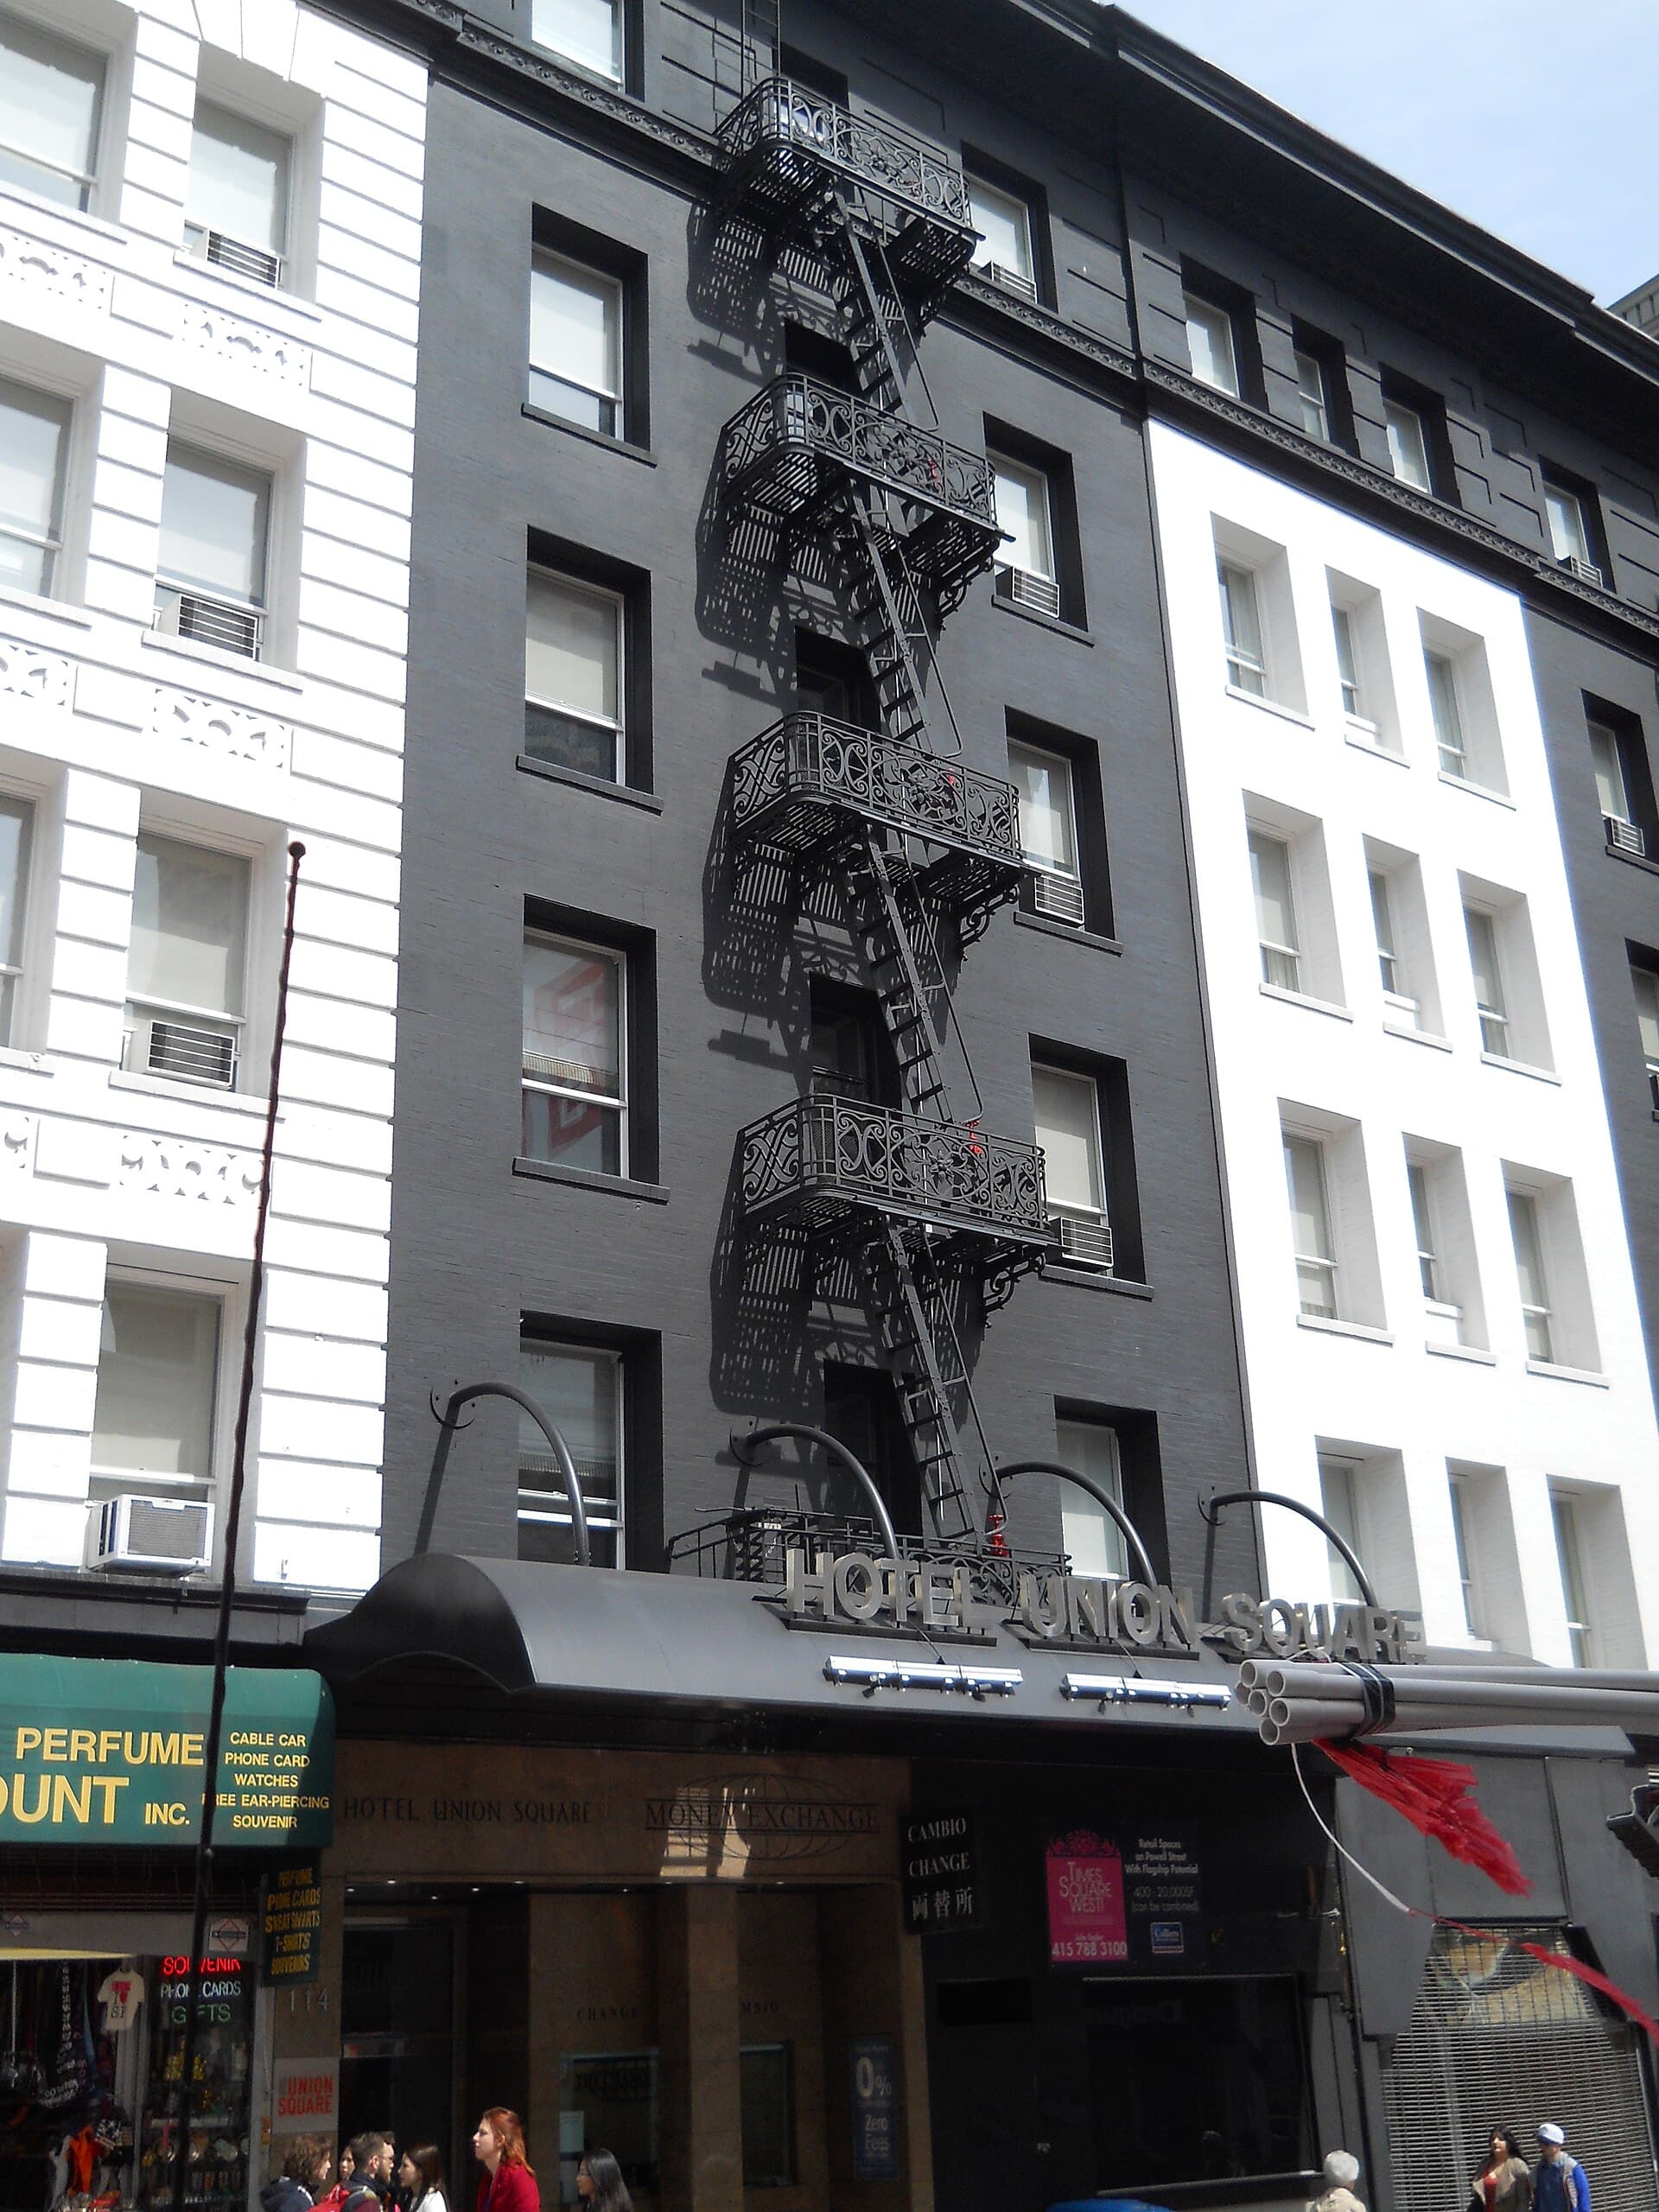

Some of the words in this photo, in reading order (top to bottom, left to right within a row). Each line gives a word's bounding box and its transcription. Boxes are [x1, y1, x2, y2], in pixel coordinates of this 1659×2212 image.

[785, 1548, 994, 1630] HOTEL
[1020, 1573, 1198, 1645] UNION
[1219, 1592, 1426, 1663] SQUARE
[16, 1726, 205, 1766] PERFUME
[230, 1732, 274, 1746] CABLE
[279, 1734, 307, 1747] CAR
[225, 1752, 269, 1767] PHONE
[274, 1754, 310, 1768] CARD
[234, 1774, 299, 1789] WATCHES
[0, 1773, 130, 1825] UNT
[144, 1802, 190, 1826] INC.
[241, 1794, 329, 1809] EAR-PIERCING
[343, 1796, 419, 1821] HOTEL
[433, 1798, 501, 1822] UNION
[513, 1800, 593, 1824] SQUARE
[646, 1802, 735, 1827] MONEY
[748, 1804, 879, 1829] EXCHANGE
[232, 1815, 298, 1829] SOUVENIR
[908, 1818, 967, 1843] CAMBIO
[909, 1853, 969, 1878] CHANGE
[1067, 1861, 1102, 1883] TIMES
[292, 1887, 321, 1906] CARDS
[1059, 1877, 1112, 1897] SQUARE
[912, 1887, 974, 1921] 両替所
[1052, 1942, 1073, 1956] 415
[1100, 1942, 1128, 1955] 3100
[161, 1983, 200, 1999] PHO
[203, 1981, 241, 1998] CARDS
[289, 1989, 328, 2012] 114
[172, 2004, 231, 2024] GFTS
[286, 2075, 333, 2095] UNION
[277, 2095, 332, 2116] SQUARE
[865, 2115, 887, 2131] Zero
